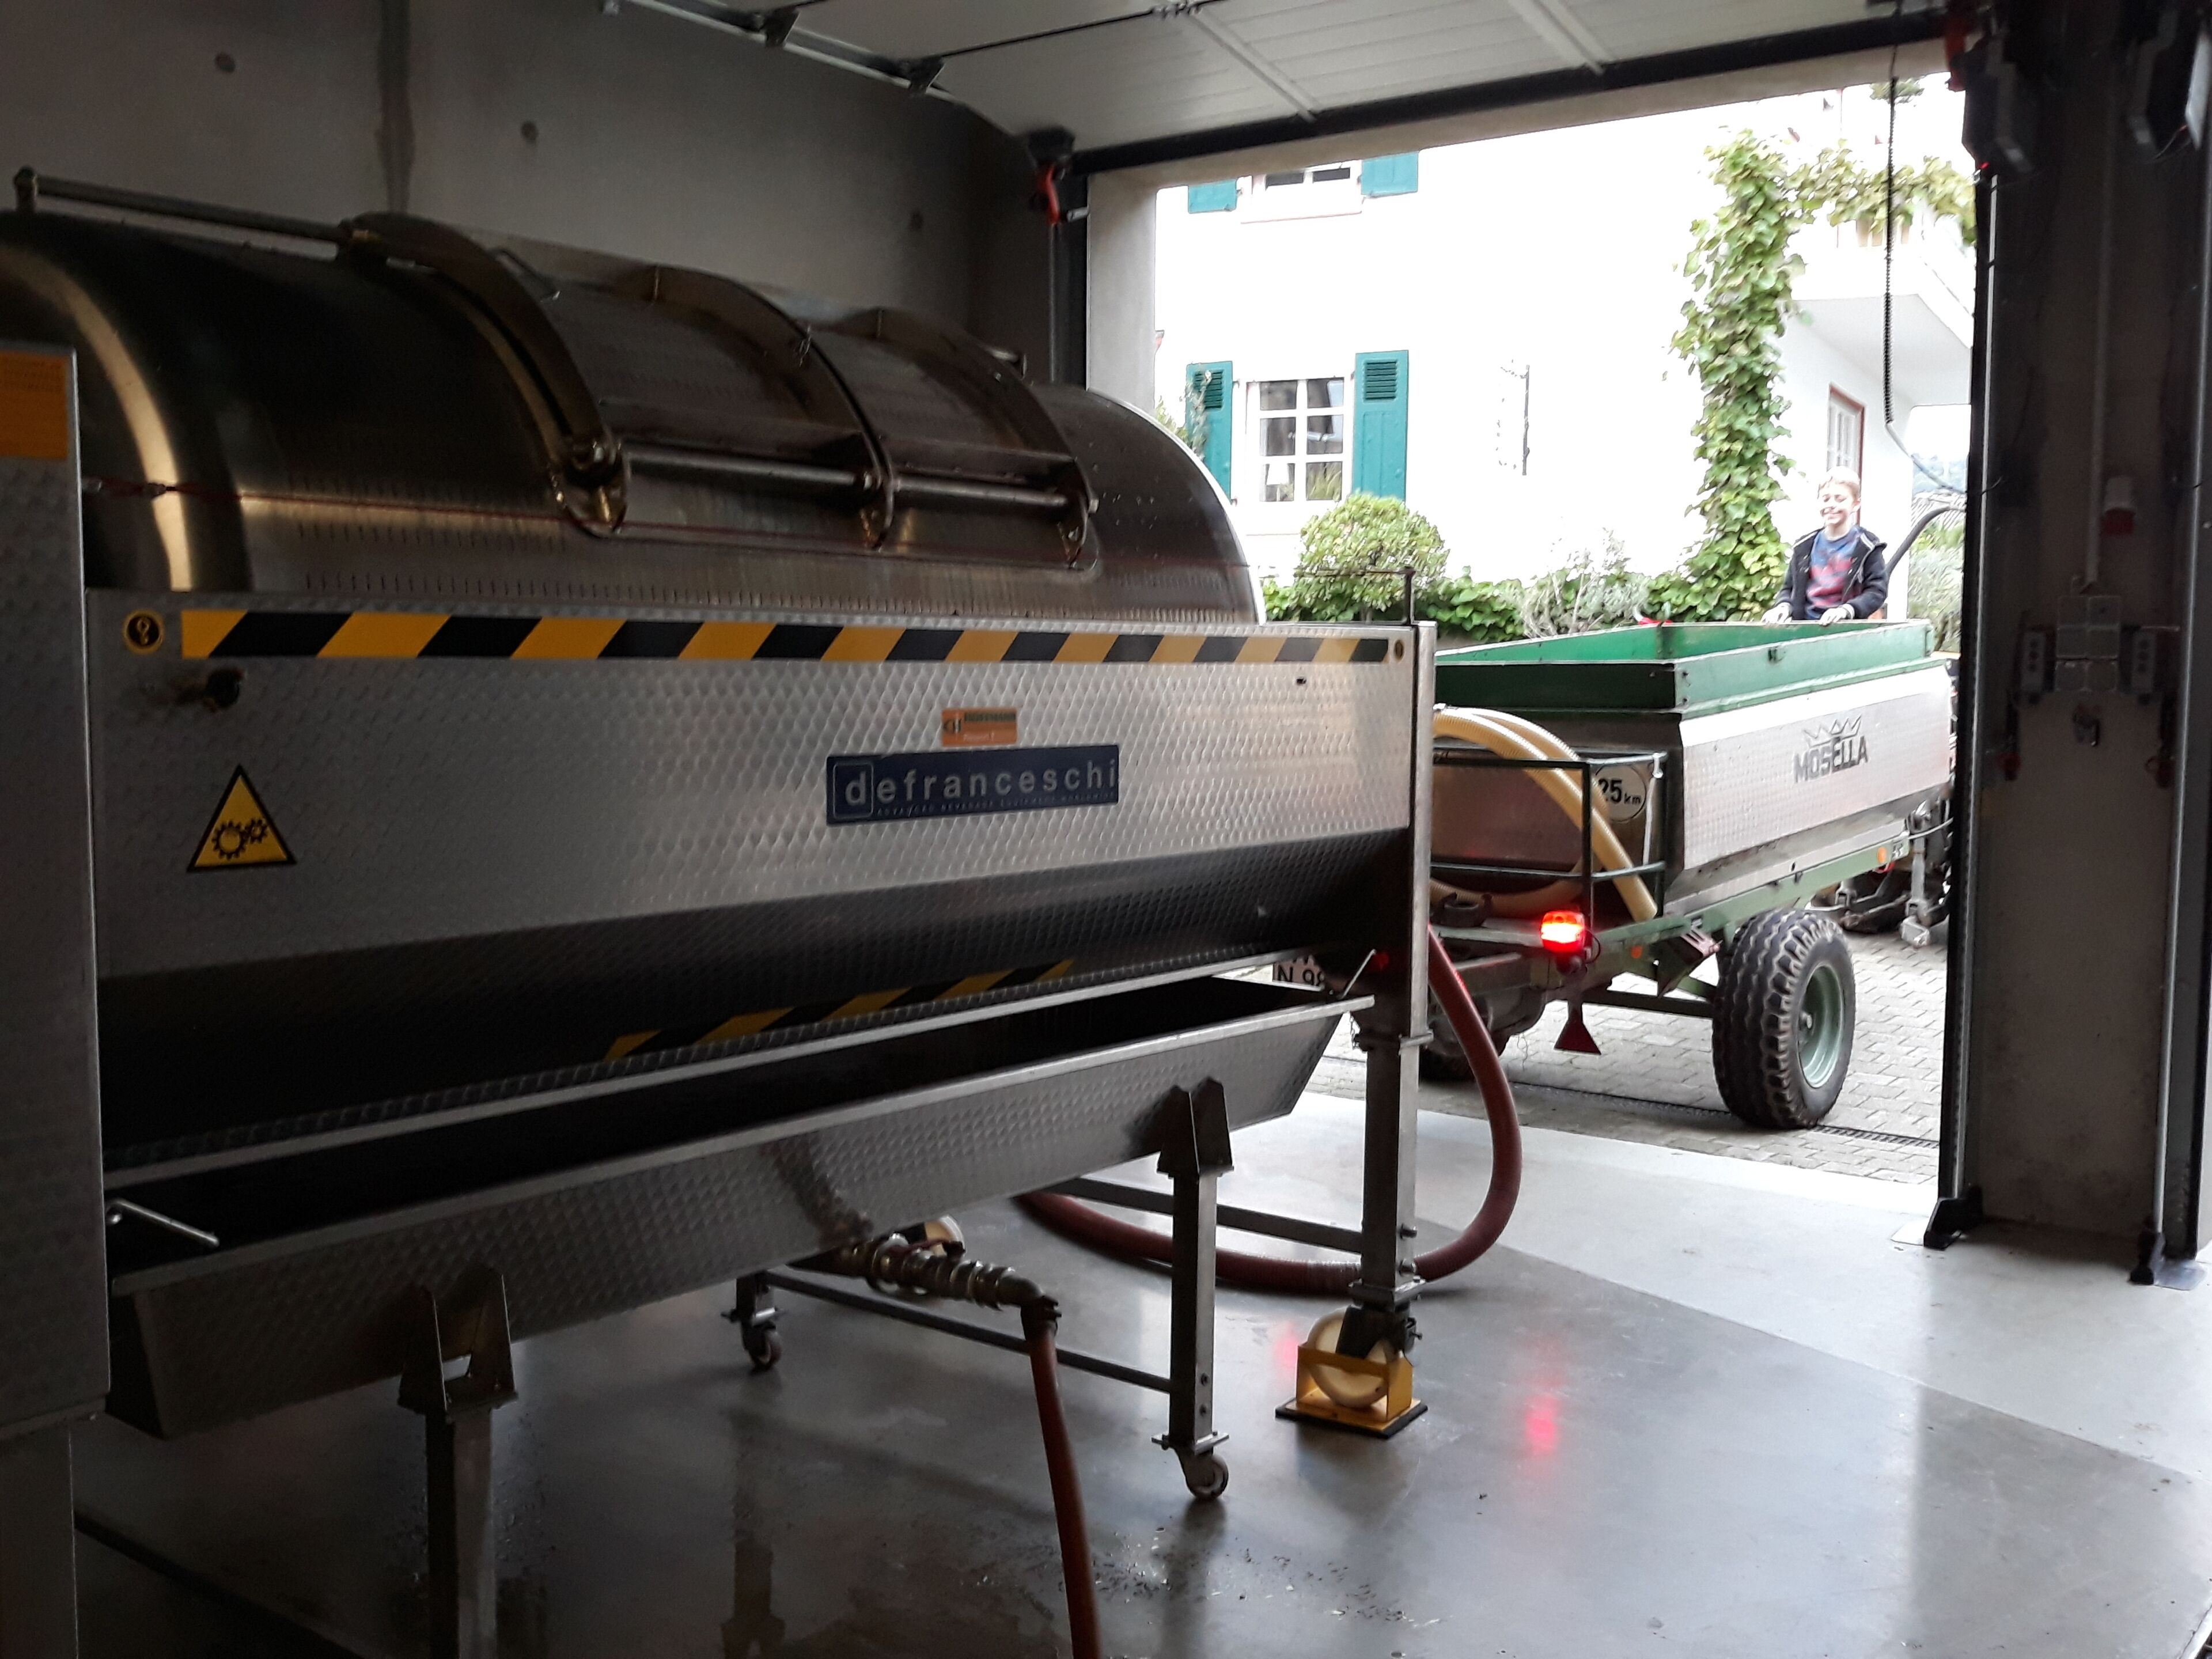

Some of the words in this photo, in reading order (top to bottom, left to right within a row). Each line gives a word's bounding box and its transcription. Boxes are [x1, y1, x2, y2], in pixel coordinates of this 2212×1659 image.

[845, 758, 1116, 806] defranceschi
[1793, 736, 1869, 784] MOSELLA
[1598, 778, 1623, 803] 25
[1624, 793, 1641, 804] km
